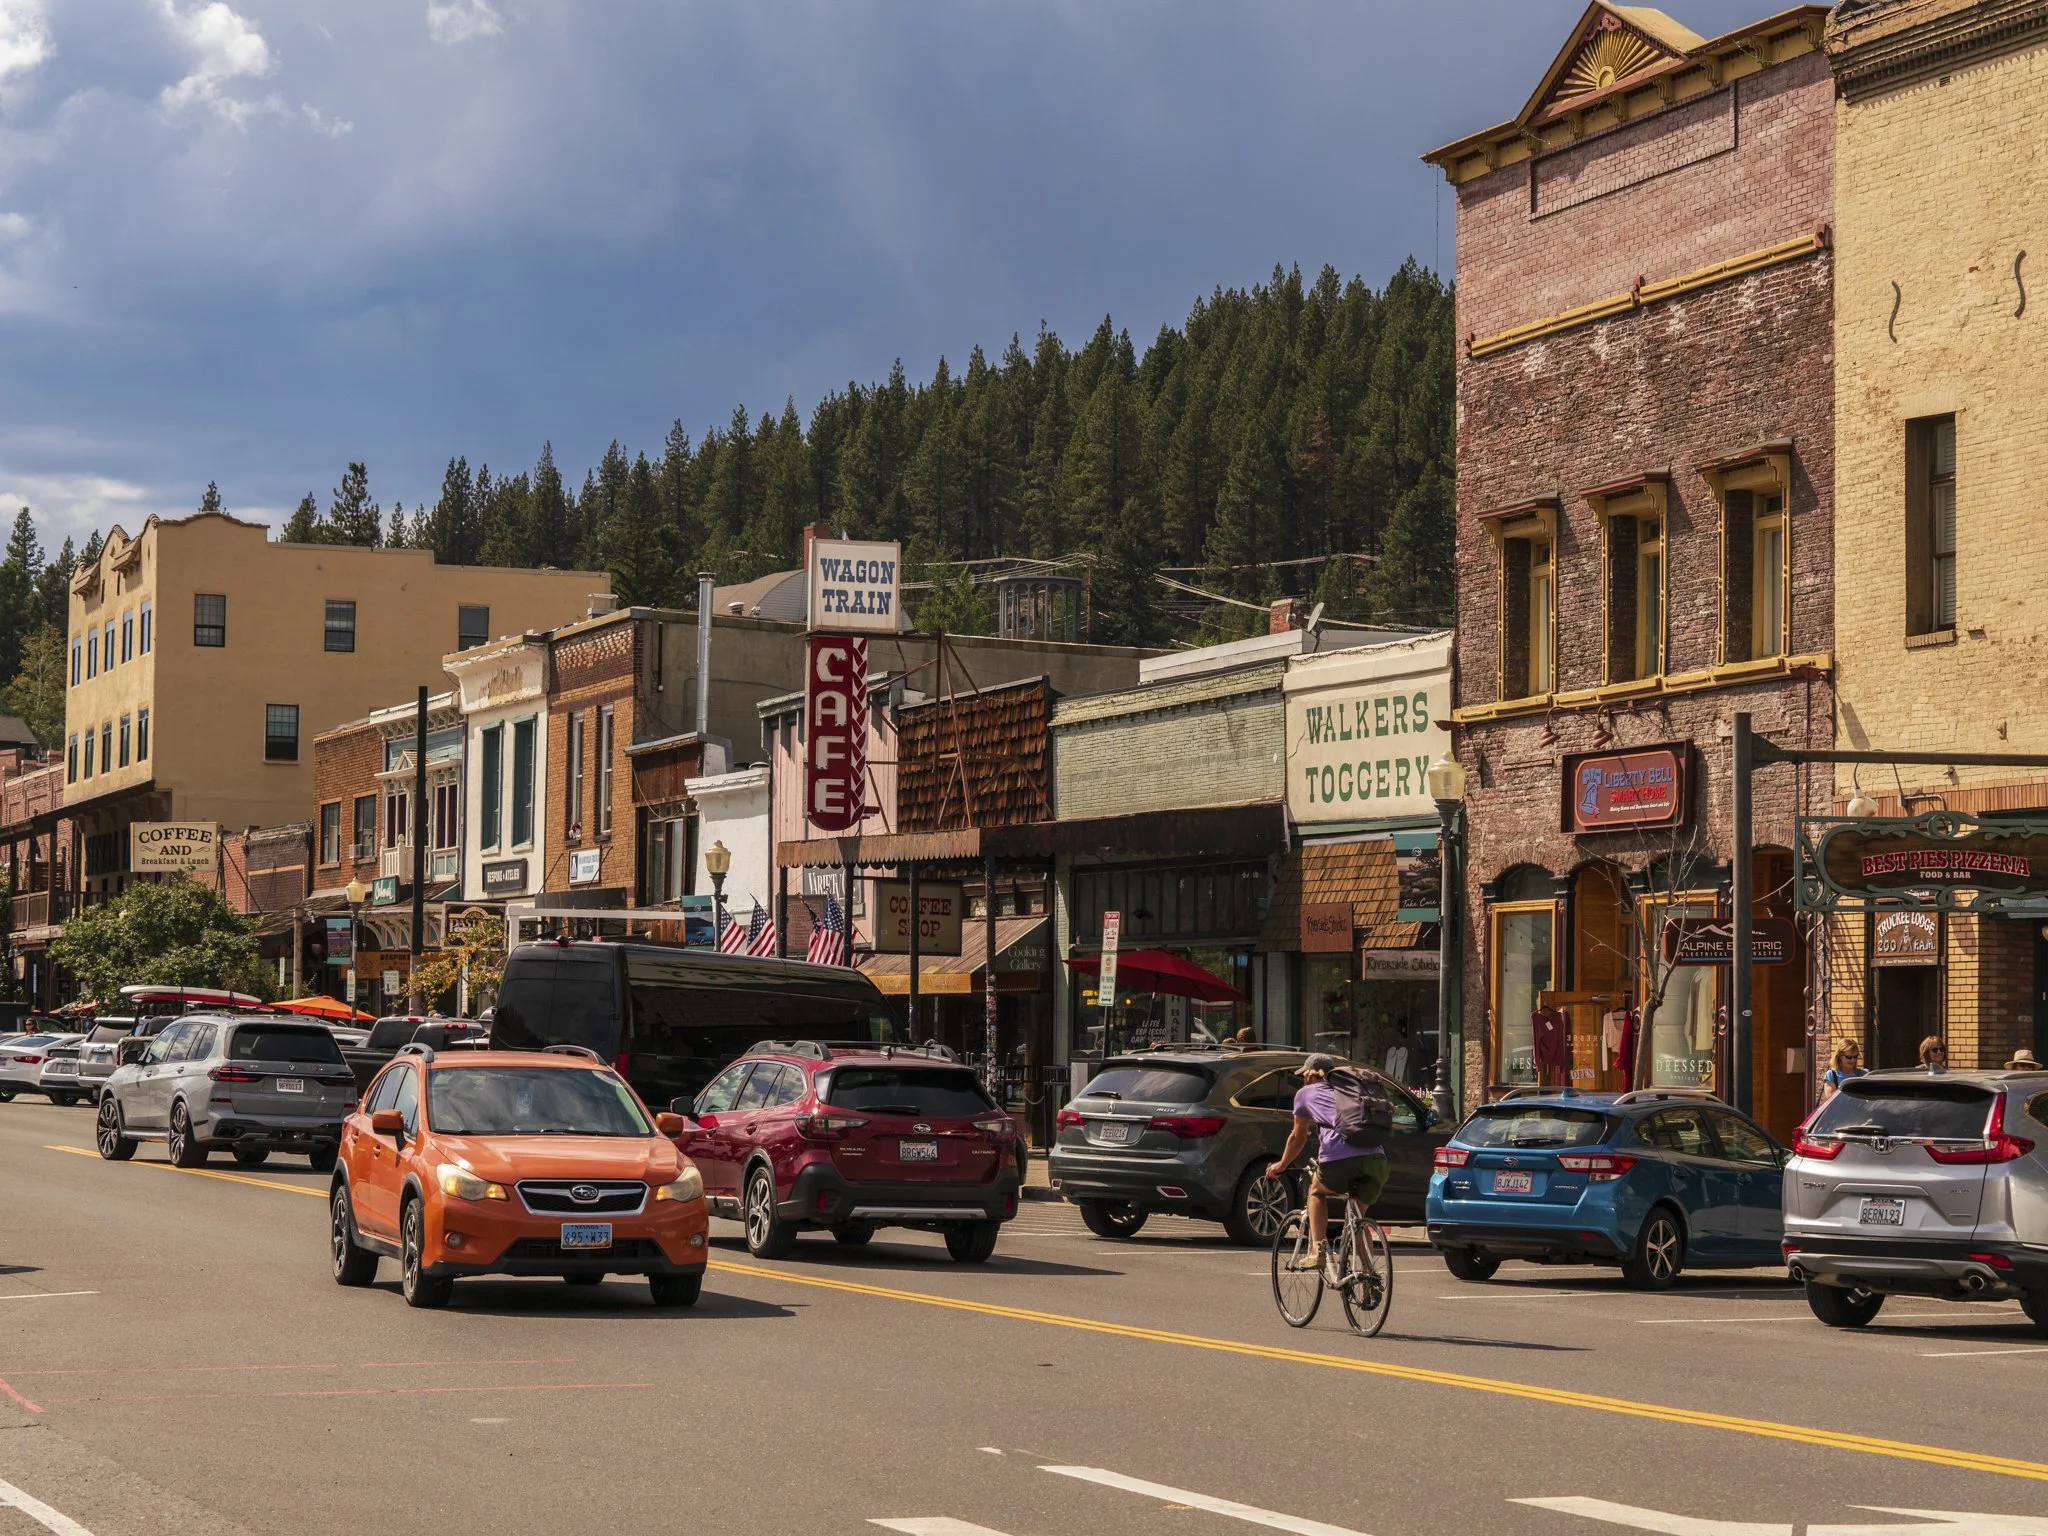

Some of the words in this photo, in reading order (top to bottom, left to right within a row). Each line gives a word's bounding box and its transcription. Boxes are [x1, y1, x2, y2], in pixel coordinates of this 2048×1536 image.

[820, 558, 895, 584] WAGON
[822, 589, 892, 615] TRAIN
[1306, 692, 1430, 744] WALKERS
[816, 647, 848, 814] CAFE
[1306, 755, 1430, 803] TOGGERY
[1604, 770, 1646, 788] LIBERTY
[1648, 767, 1673, 783] BELL
[1609, 788, 1639, 803] SMART
[1642, 786, 1666, 800] HOME
[138, 828, 213, 843] COFFEE
[159, 845, 192, 855] AND
[1862, 852, 1906, 876] BEST
[1909, 850, 1948, 869] PIES
[1951, 850, 2030, 877] PIZZERIA
[1920, 871, 1942, 879] FOOD
[1953, 871, 1971, 879] BAR
[889, 896, 951, 916] COFEE
[1402, 900, 1418, 908] Take
[1420, 898, 1437, 907] Care
[897, 920, 941, 938] SOP
[1877, 912, 1910, 937] TRUCKEE
[1911, 912, 1936, 936] LODGE
[1681, 942, 1724, 951] ALPINE
[1878, 940, 1896, 951] 200
[1010, 959, 1042, 970] Gallery
[1366, 957, 1409, 971] Riverside
[1136, 1028, 1167, 1036] ESPESSO
[1656, 1060, 1713, 1073] DRESSED
[1573, 1070, 1594, 1079] OPEN
[902, 1147, 936, 1158] 8RGW546
[1497, 1180, 1529, 1189] 8JXJ142
[1862, 1208, 1900, 1221] 8ERN193
